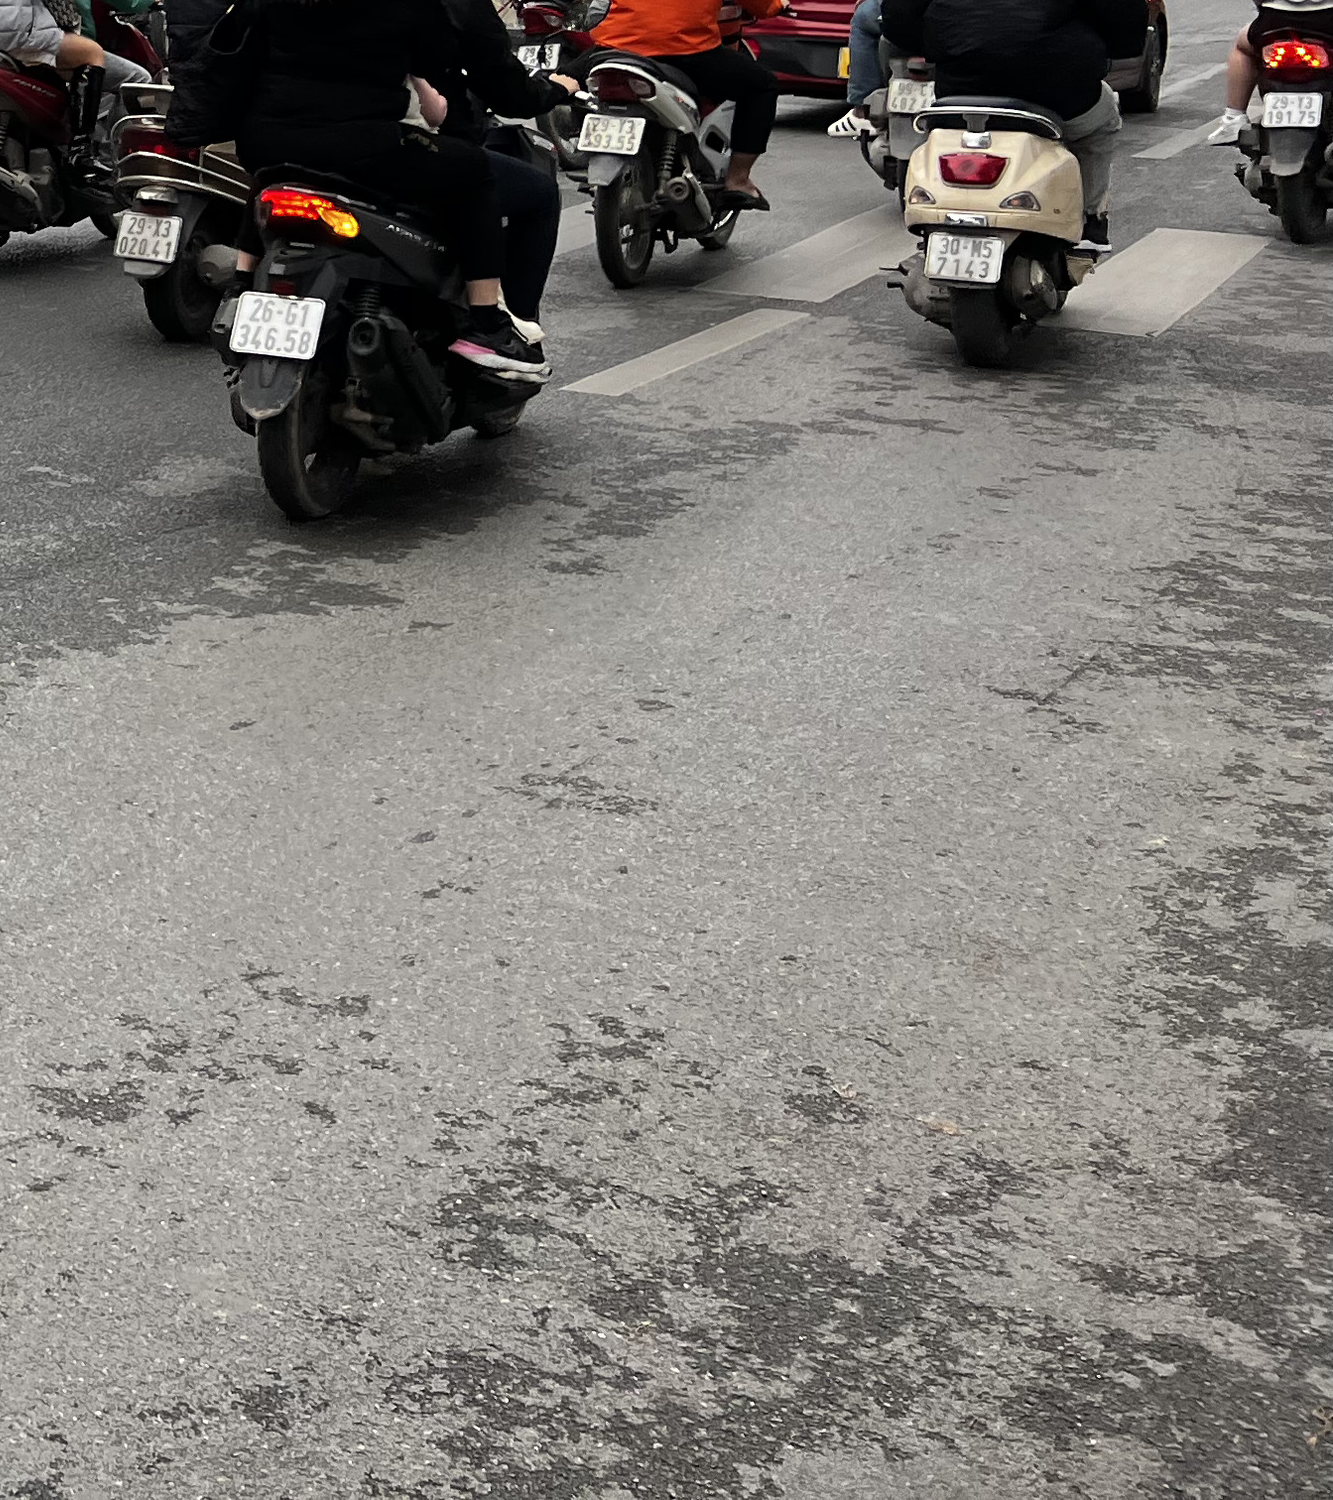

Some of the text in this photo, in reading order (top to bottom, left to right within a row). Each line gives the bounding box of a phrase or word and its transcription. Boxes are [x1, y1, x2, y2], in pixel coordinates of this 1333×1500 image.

[1268, 110, 1317, 124] 191.75
[127, 217, 172, 238] 29-X3
[118, 236, 172, 260] 020.41
[939, 237, 993, 259] 30-M5
[936, 257, 990, 279] 7143
[249, 298, 310, 327] 26-G1
[237, 323, 312, 354] 346.58
